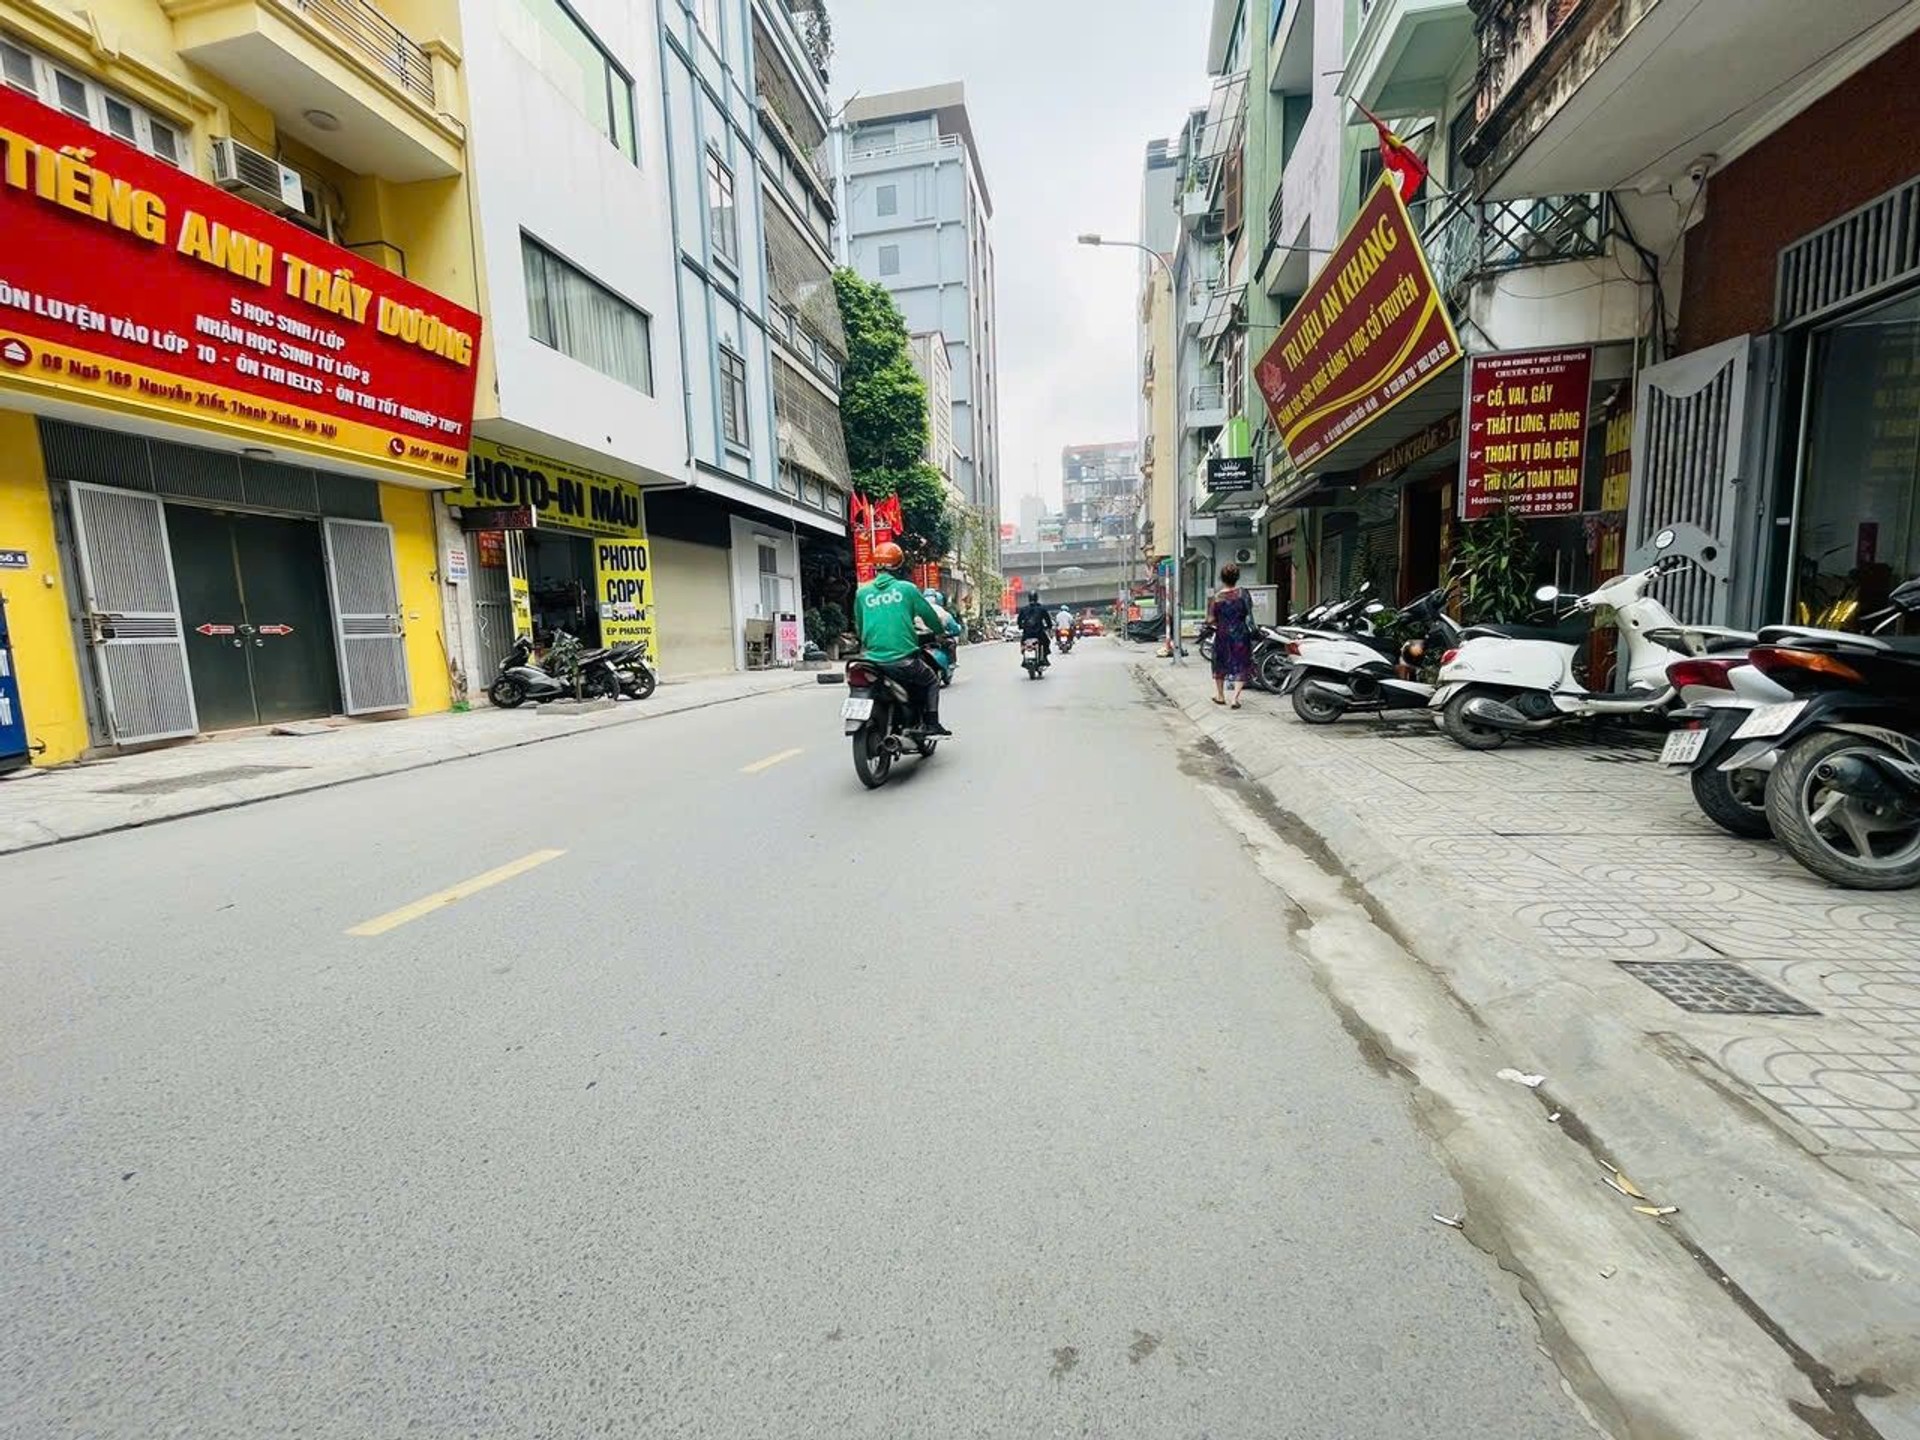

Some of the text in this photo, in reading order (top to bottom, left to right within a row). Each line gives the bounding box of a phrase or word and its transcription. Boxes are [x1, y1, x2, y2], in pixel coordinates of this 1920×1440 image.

[0, 129, 472, 367] TIẾNG ANH THẦY DƯƠNG
[1281, 214, 1398, 373] TRỊ LIỆU AN KHANG
[1377, 273, 1419, 328] TRUYỀN
[230, 298, 242, 315] 5
[243, 302, 275, 332] HỌC
[0, 281, 29, 313] ÔN
[35, 298, 105, 332] LUYỆN
[110, 312, 150, 344] VÀO
[153, 329, 189, 354] LỚP
[197, 344, 216, 363] 10
[236, 355, 260, 376] ÔN
[262, 363, 284, 383] THI
[286, 370, 323, 394] IELTS
[336, 384, 354, 404] ÔN
[357, 392, 375, 410] THI
[377, 397, 399, 416] TỐT
[400, 405, 437, 429] NGHIỆP
[437, 416, 463, 434] THPT
[196, 314, 370, 384] NHẬN HỌC SINH TỪ LỚP 8
[139, 377, 193, 402] Nguyễn
[231, 400, 267, 419] Thanh
[1508, 386, 1528, 406] VAI,
[1549, 408, 1581, 431] HÔNG
[1484, 436, 1580, 465] THOÁT VỊ ĐĨA ĐỆM
[473, 455, 584, 518] HOTO-IN
[1527, 466, 1551, 489] TOÀN
[1553, 464, 1578, 487] THÂN
[599, 545, 647, 571] PHOTO
[607, 579, 644, 604] COPY
[865, 589, 903, 608] Grab
